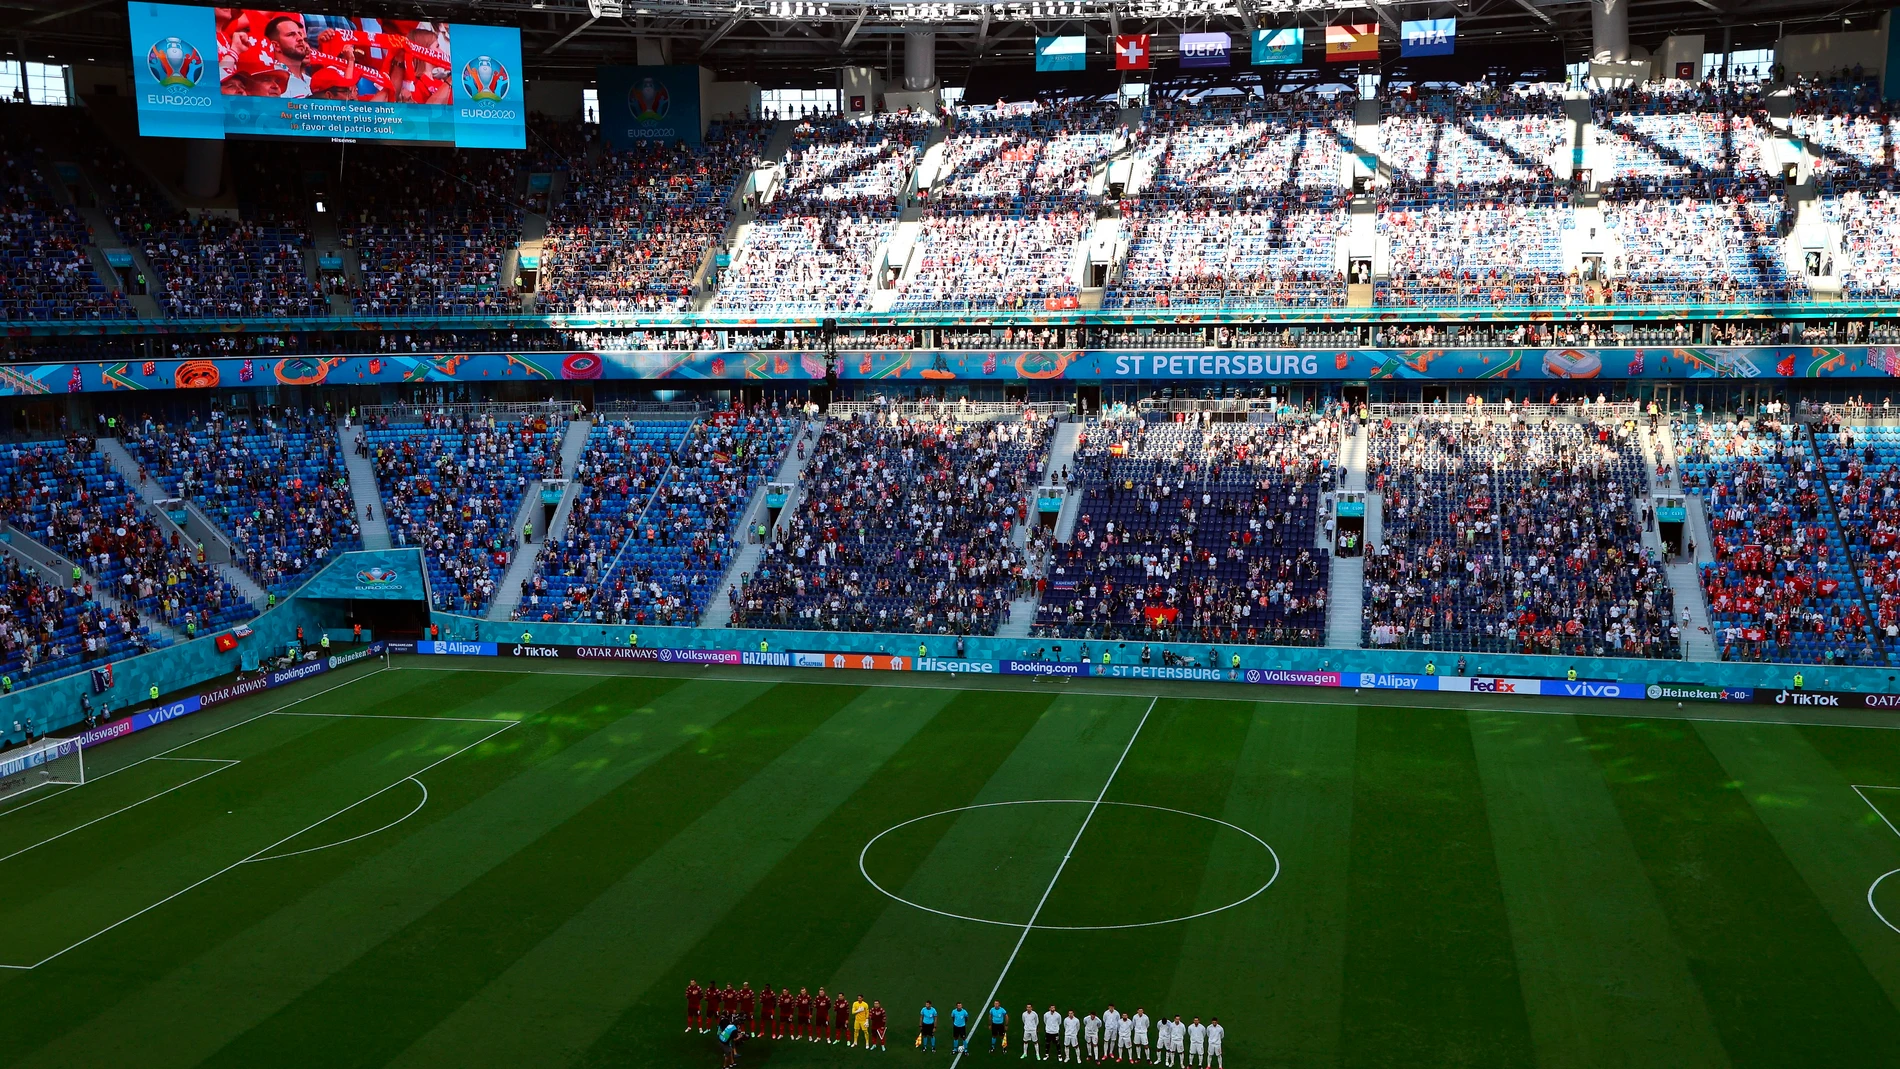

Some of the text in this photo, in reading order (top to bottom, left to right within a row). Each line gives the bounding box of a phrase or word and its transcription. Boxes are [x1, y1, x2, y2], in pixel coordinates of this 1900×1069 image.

[1409, 30, 1447, 46] FIFA
[1184, 44, 1225, 56] UEFA
[148, 94, 212, 106] EURO2020
[287, 102, 395, 114] Eure fromme Seele ahnt
[461, 109, 515, 119] EURO2020
[295, 112, 311, 120] ciel
[313, 114, 351, 122] montent
[354, 115, 372, 125] plus
[374, 116, 403, 125] joyeux
[302, 123, 326, 131] favor
[328, 124, 342, 132] del
[344, 125, 371, 133] patrio
[627, 128, 675, 138] EURO2020
[1115, 355, 1318, 375] ST PETERSBURG
[449, 642, 481, 655] Alipay
[524, 647, 559, 658] TikTok
[576, 647, 658, 659] QATAR AIRWAYS
[337, 650, 367, 665] Heineken
[675, 650, 737, 663] Volkswagen
[742, 652, 790, 666] GAZPROM
[917, 658, 993, 673] Hisense
[1011, 662, 1078, 674] Booking.com
[274, 663, 321, 683] Booking.com
[1112, 665, 1221, 680] ST PETERSBURG
[1264, 671, 1336, 684] Volkswagen
[1377, 675, 1418, 689] Alipay
[1470, 678, 1515, 693] FedEx
[200, 677, 267, 706] QATAR AIRWAYS
[1565, 681, 1620, 697] vivo
[1662, 688, 1718, 699] Heineken
[1791, 693, 1839, 706] TikTok
[148, 704, 185, 724] vivo
